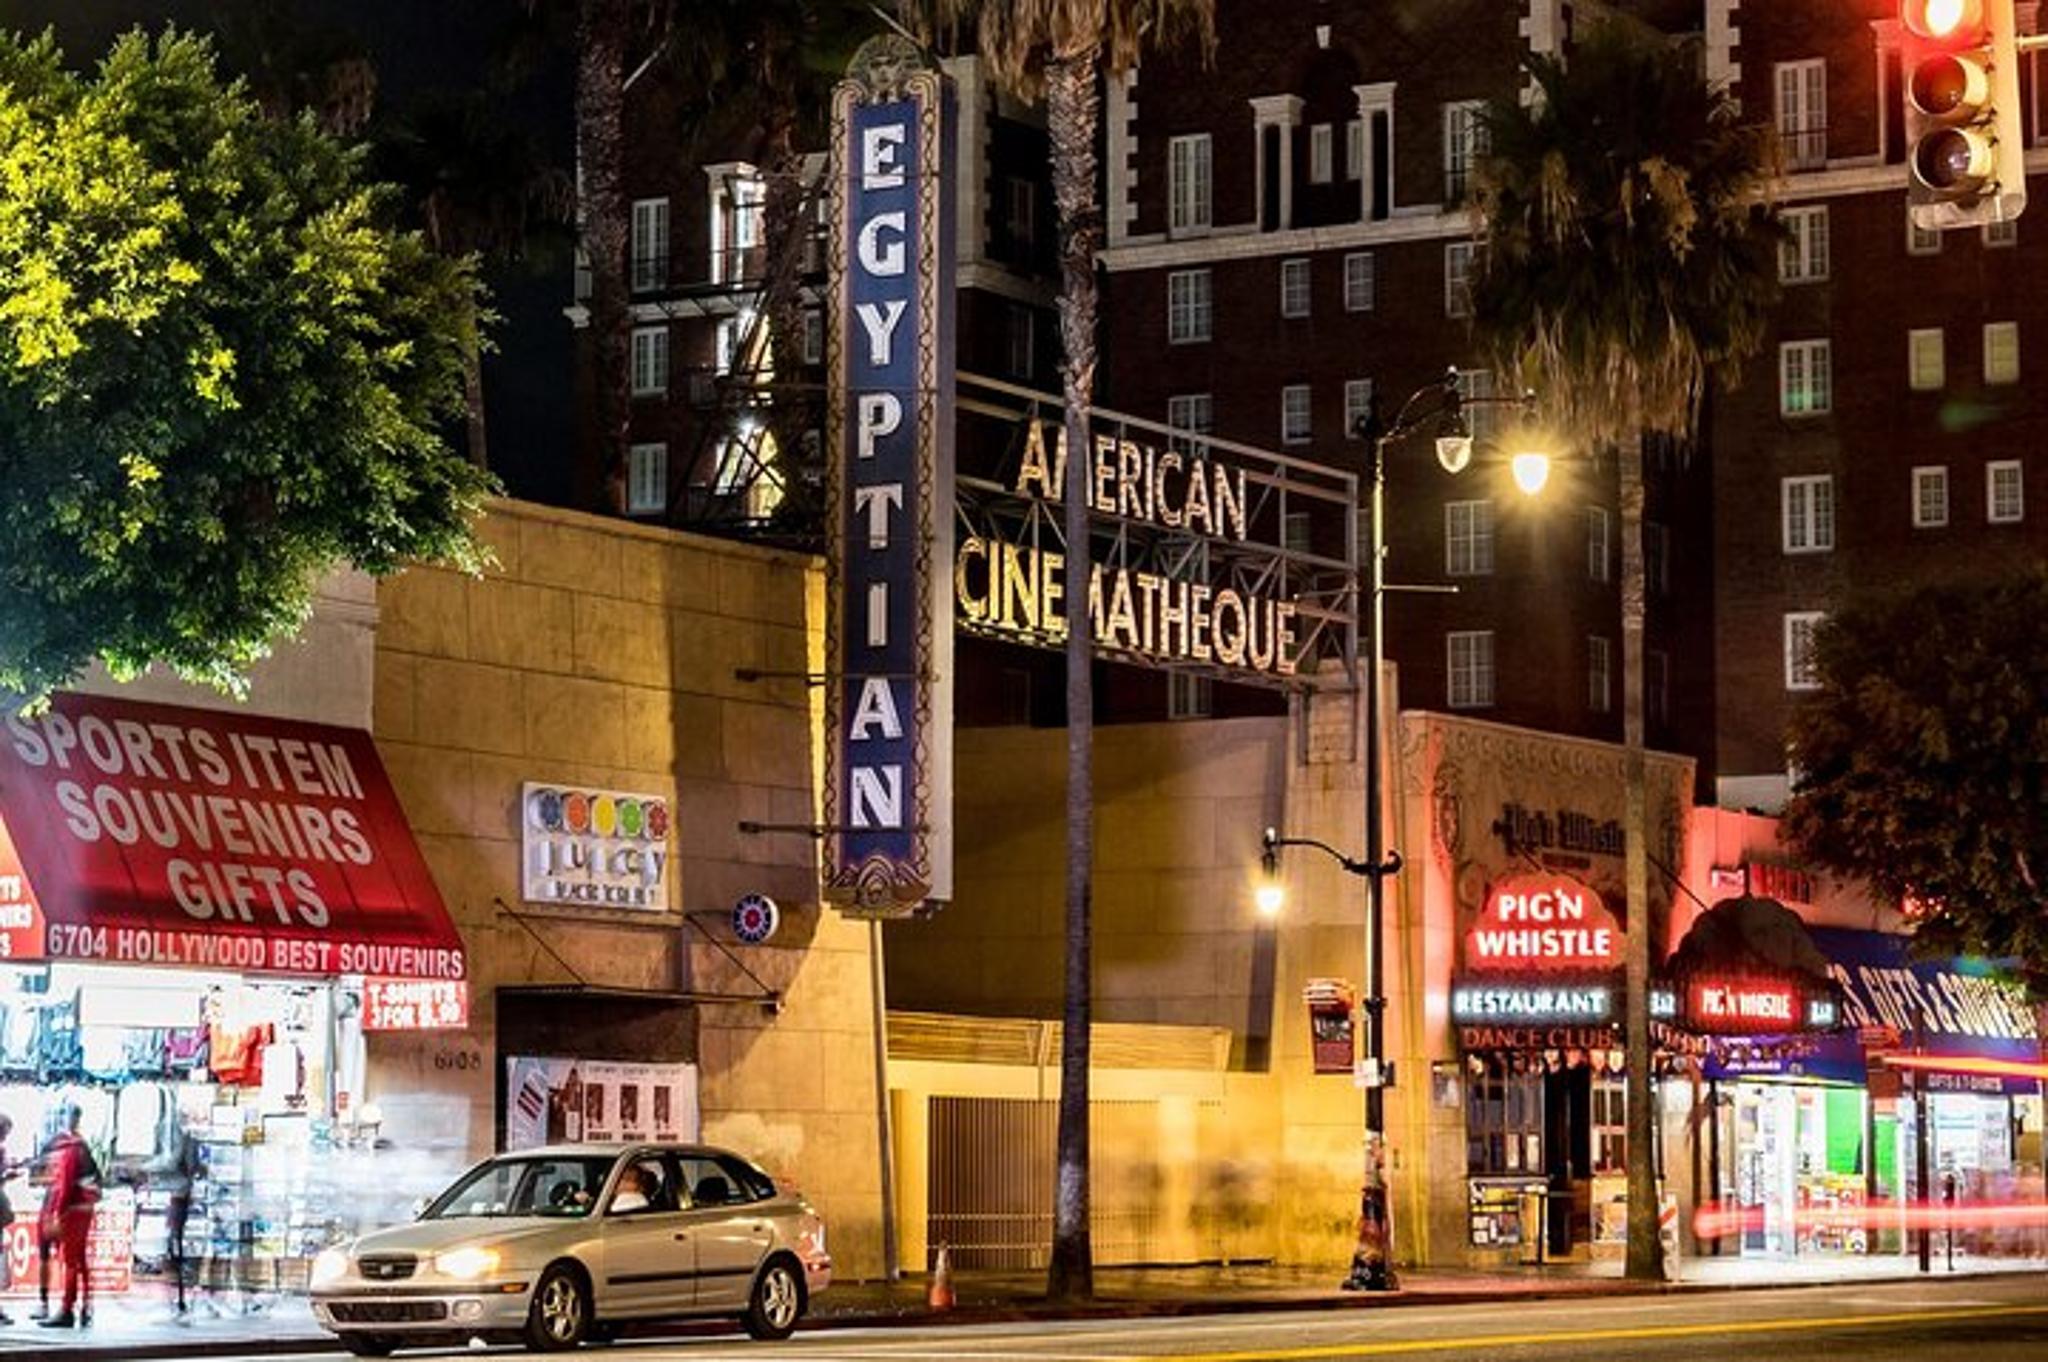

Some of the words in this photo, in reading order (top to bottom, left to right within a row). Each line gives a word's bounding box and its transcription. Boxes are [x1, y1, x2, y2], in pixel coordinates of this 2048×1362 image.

[849, 123, 908, 829] EGYPTIAN
[6, 708, 231, 787] SPORTS
[230, 733, 365, 800] ITEM
[55, 780, 373, 865] SOUVENIRS
[167, 858, 330, 928] GIFTS
[48, 922, 108, 958] 6704
[117, 928, 266, 967] HOLLYWOOD
[273, 939, 330, 971] BEST
[340, 943, 464, 978] SOUVENIRS
[1475, 928, 1611, 957] WHISTLE
[1453, 988, 1606, 1015] RESTAURANT
[1463, 1026, 1542, 1048] DANCE
[1547, 1026, 1615, 1048] CLUB
